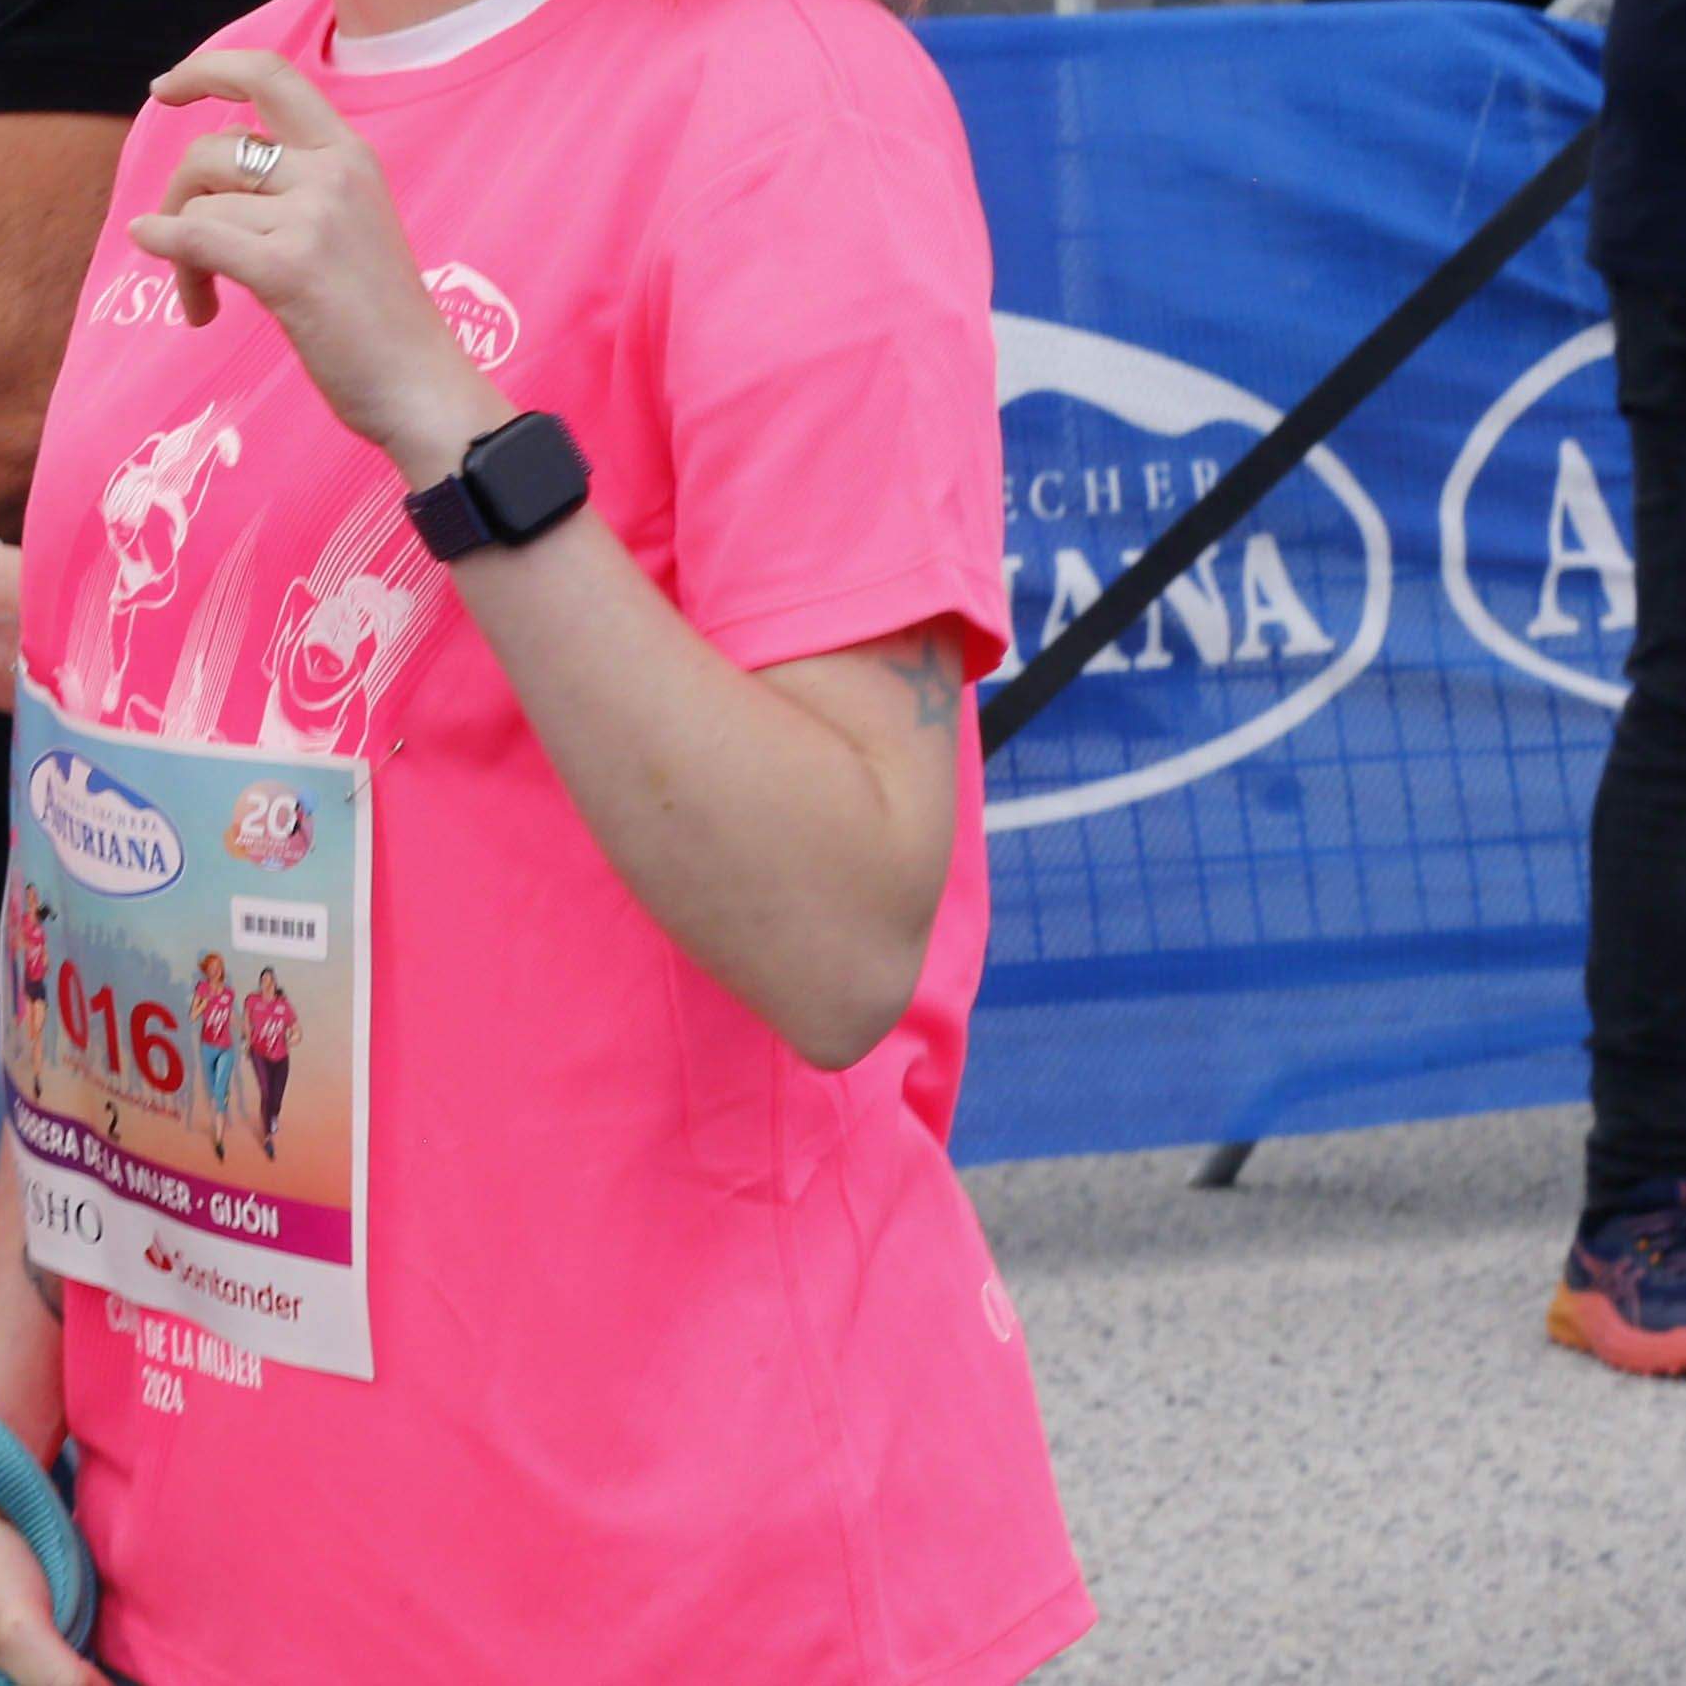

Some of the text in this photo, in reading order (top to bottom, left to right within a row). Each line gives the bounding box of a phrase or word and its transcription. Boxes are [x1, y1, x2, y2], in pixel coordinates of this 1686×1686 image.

[240, 790, 299, 842] 20
[57, 958, 185, 1094] 016
[124, 1161, 192, 1215] MUJER
[209, 1191, 280, 1239] GIJÓN
